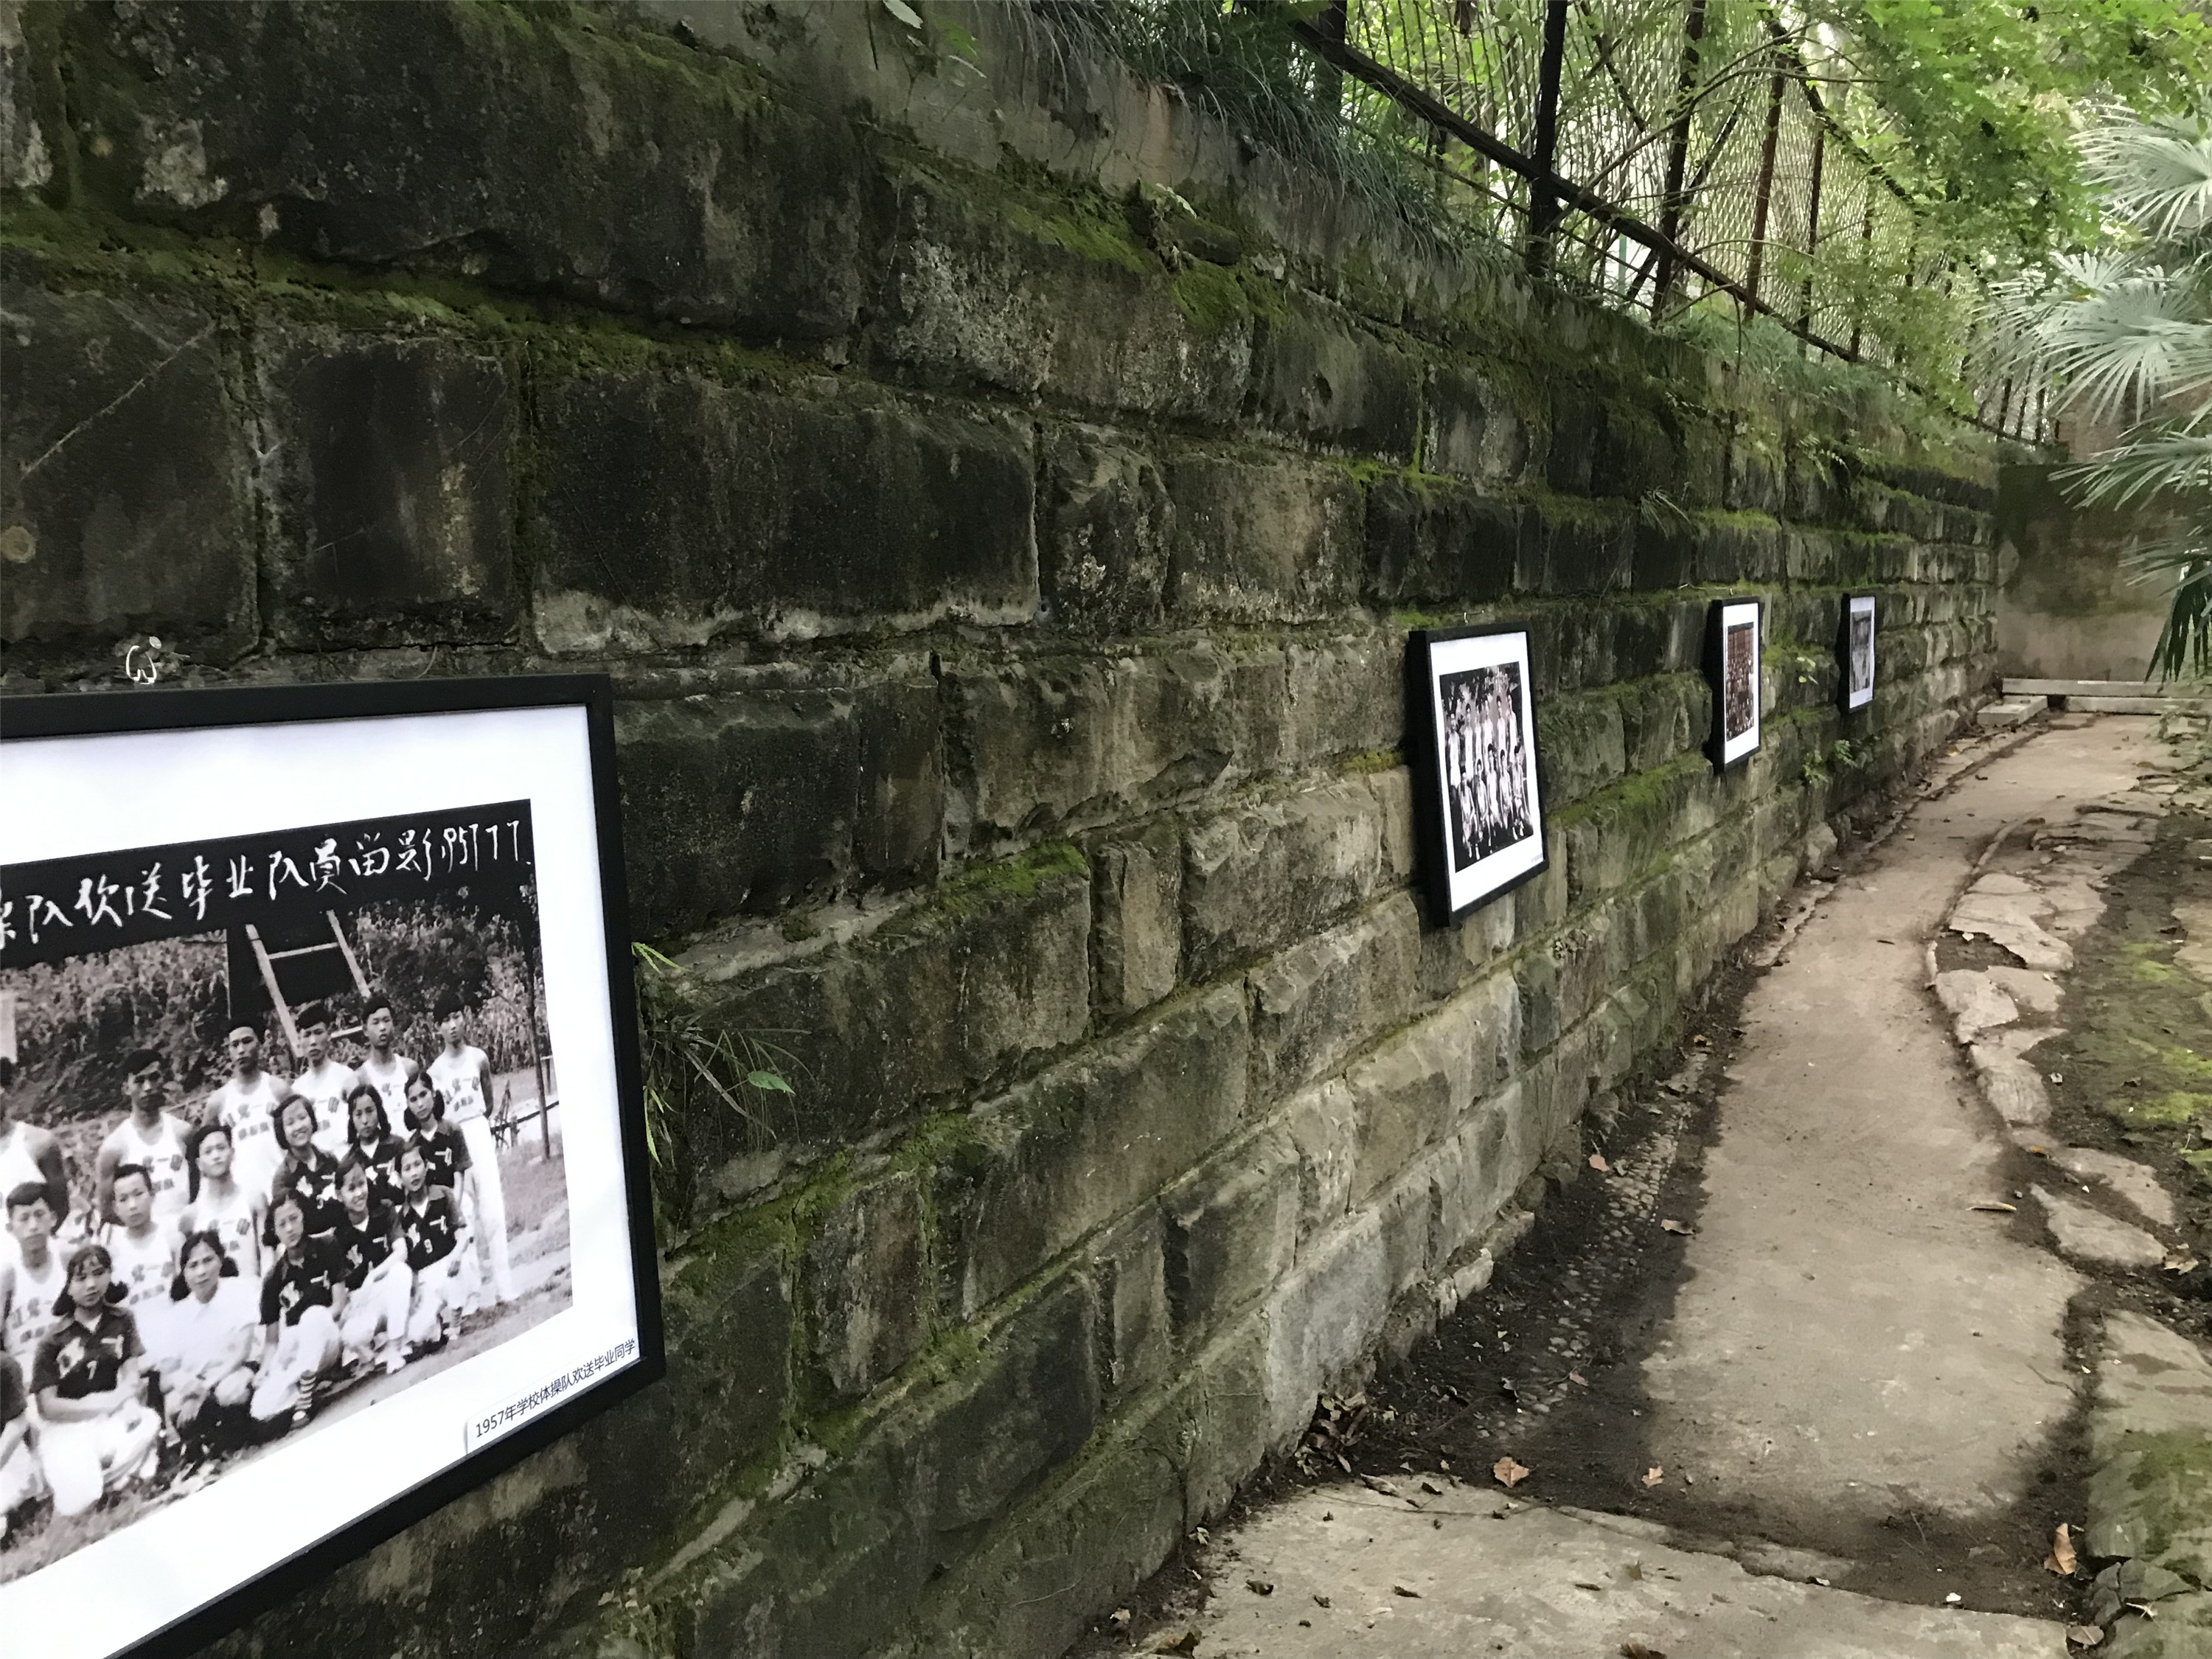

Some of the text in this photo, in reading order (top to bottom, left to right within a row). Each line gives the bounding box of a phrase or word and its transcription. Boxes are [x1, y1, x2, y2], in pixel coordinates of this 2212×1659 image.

[476, 1338, 636, 1438] 1957年学校体操队欢送毕业同学
